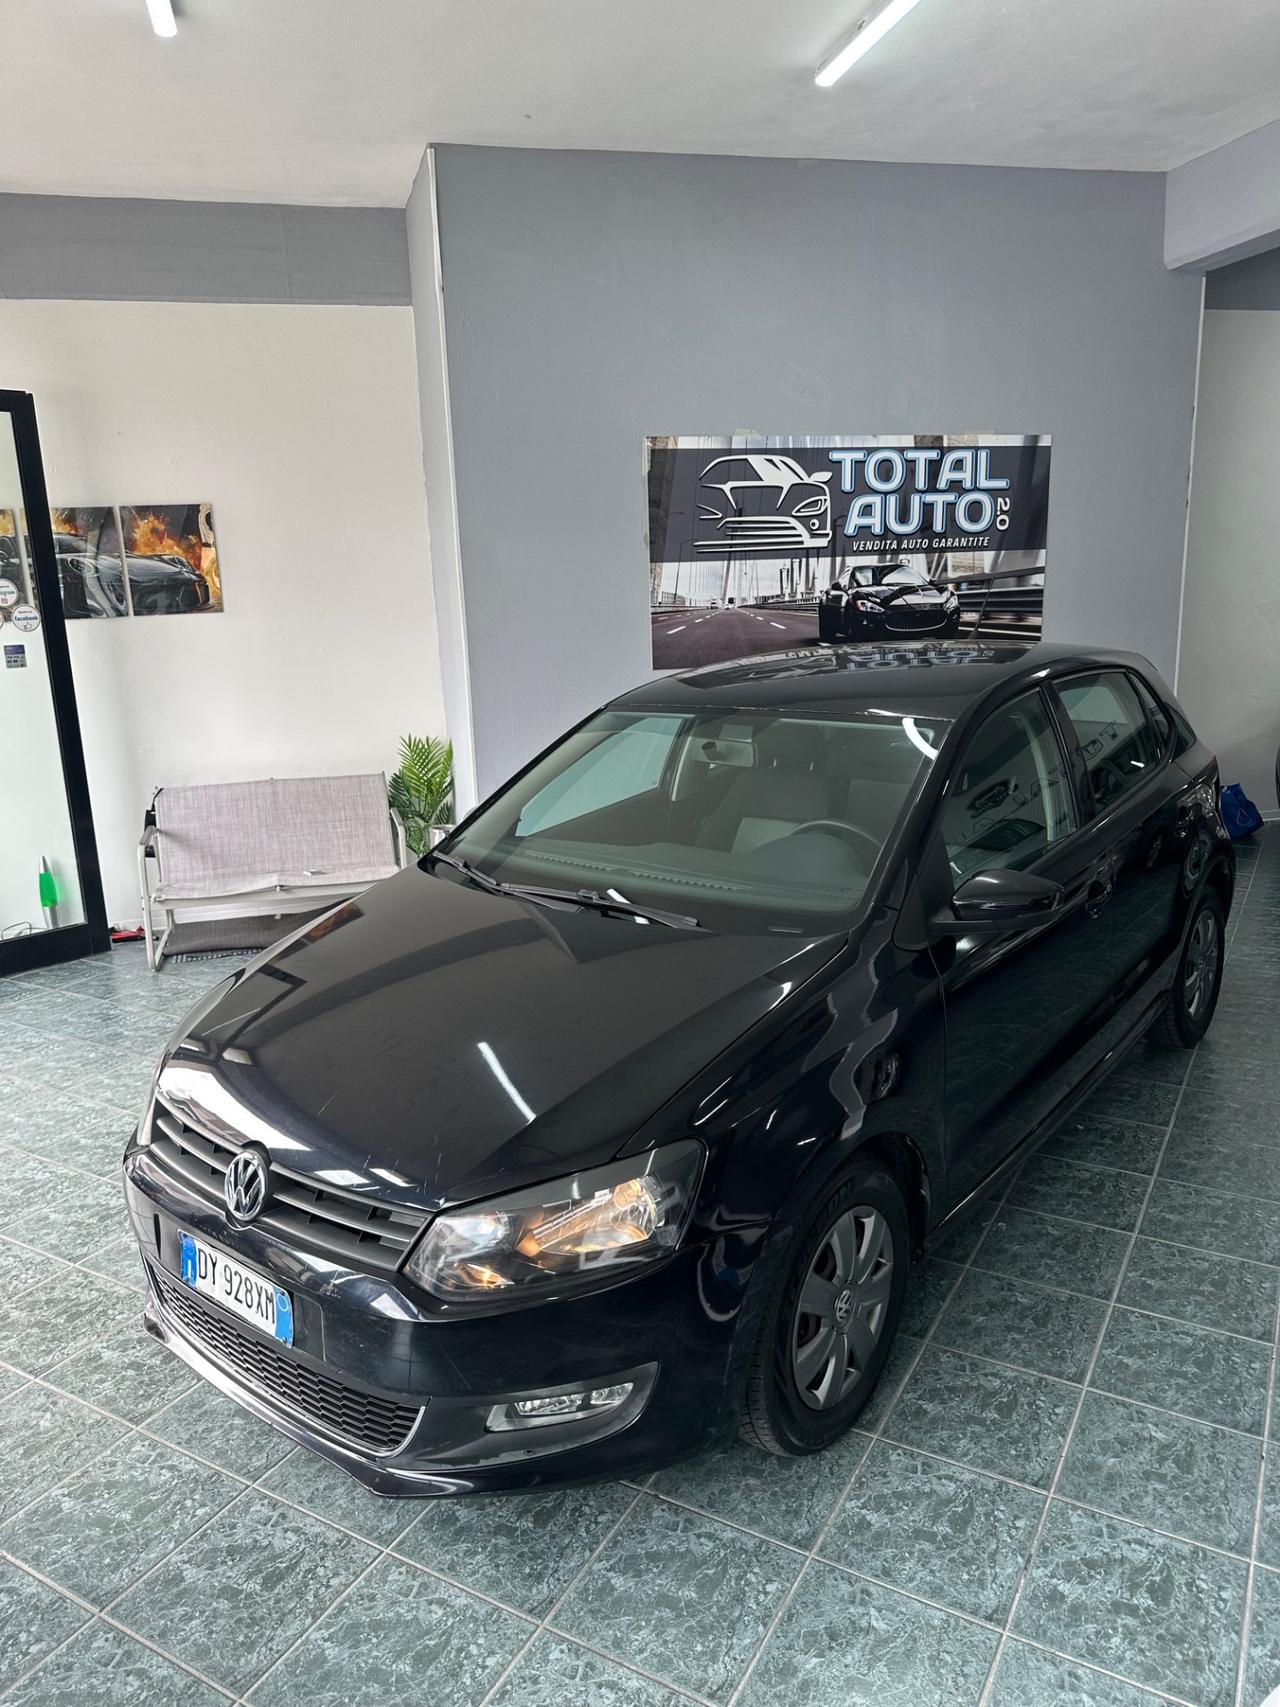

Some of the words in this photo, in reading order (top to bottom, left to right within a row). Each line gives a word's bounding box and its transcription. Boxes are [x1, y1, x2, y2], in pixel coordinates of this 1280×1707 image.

[829, 449, 1010, 493] TOTAL
[844, 491, 995, 536] AUTO
[996, 497, 1011, 530] 2.0
[853, 539, 898, 551] VENDITA
[901, 538, 929, 549] AUTO
[932, 536, 990, 548] GARANTITE
[198, 1247, 218, 1285] DY
[223, 1263, 275, 1325] 928XM
